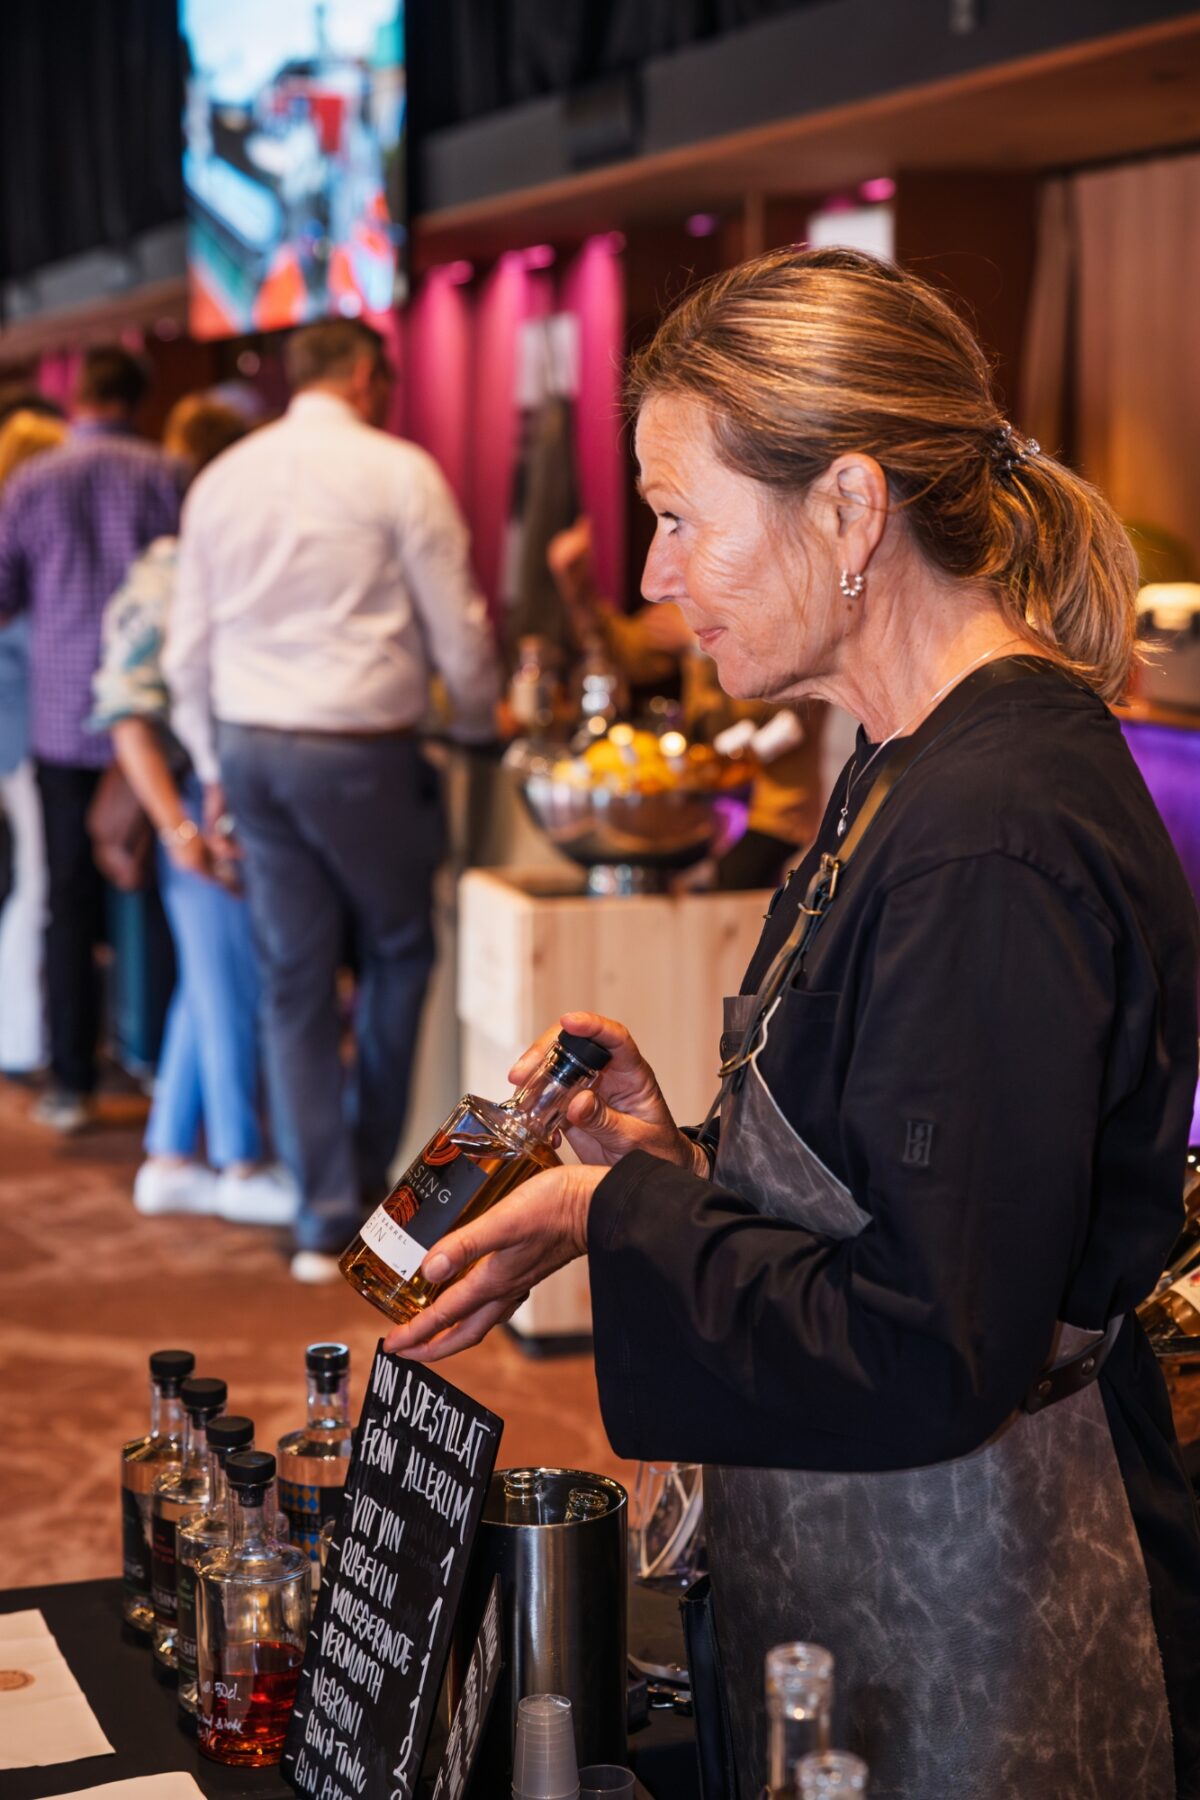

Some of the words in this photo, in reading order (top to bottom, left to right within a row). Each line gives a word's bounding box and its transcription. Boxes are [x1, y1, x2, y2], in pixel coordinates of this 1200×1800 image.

[372, 1353, 400, 1406] VIN
[409, 1381, 491, 1478] DESTILLAT
[359, 1411, 399, 1475] FRÅN
[401, 1445, 475, 1545] ALLERUM
[373, 1506, 406, 1554] VIN
[440, 1546, 455, 1587] 1
[320, 1621, 385, 1705] VERMOUTH
[408, 1695, 420, 1738] 1
[330, 1582, 415, 1676] MOUSSERANDE
[420, 1652, 431, 1696] 1
[428, 1596, 443, 1651] 1
[304, 1708, 328, 1756] GIN
[335, 1741, 368, 1795] TONIC
[311, 1666, 364, 1741] NEGRONI
[392, 1735, 413, 1786] 2
